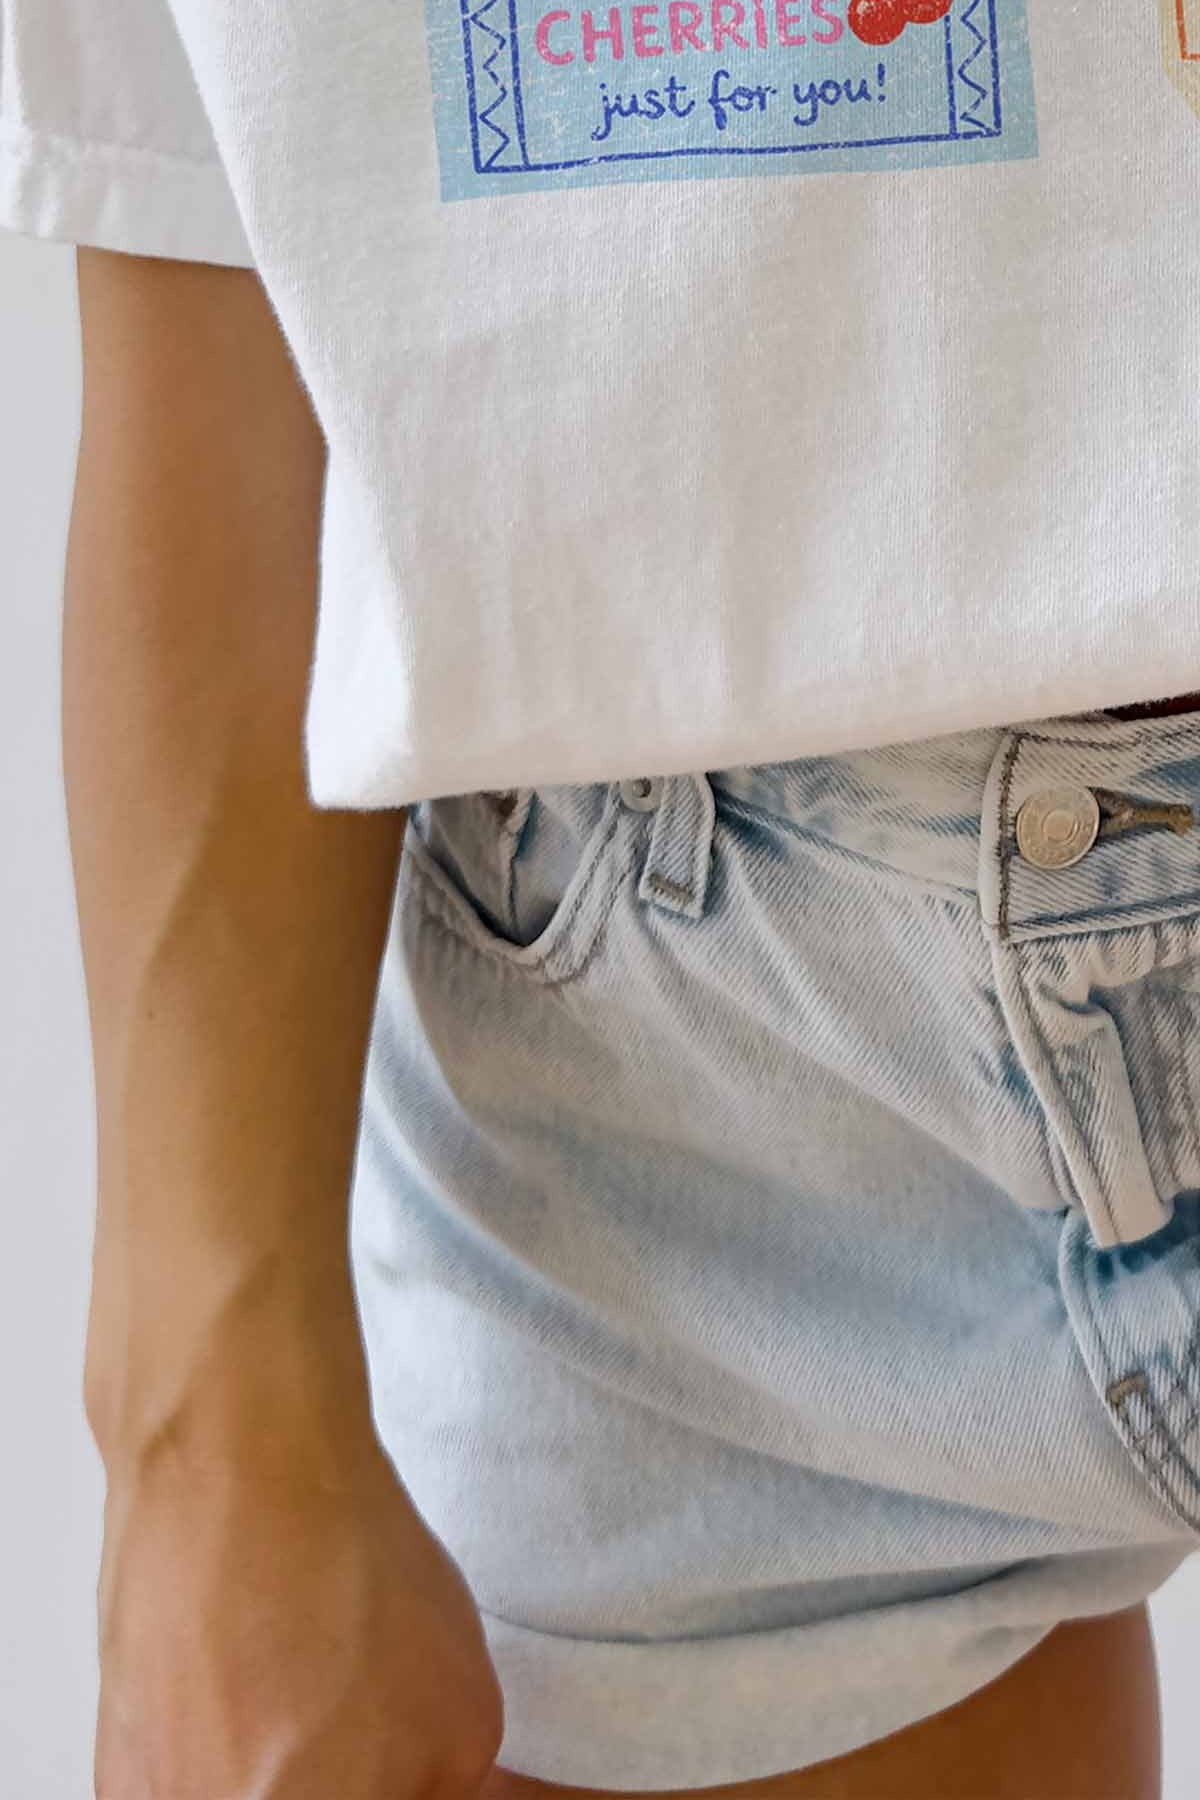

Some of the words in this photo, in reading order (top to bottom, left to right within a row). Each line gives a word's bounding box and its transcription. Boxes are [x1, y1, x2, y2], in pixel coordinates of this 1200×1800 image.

[590, 76, 695, 142] just
[707, 69, 778, 131] for
[793, 63, 888, 126] you!
